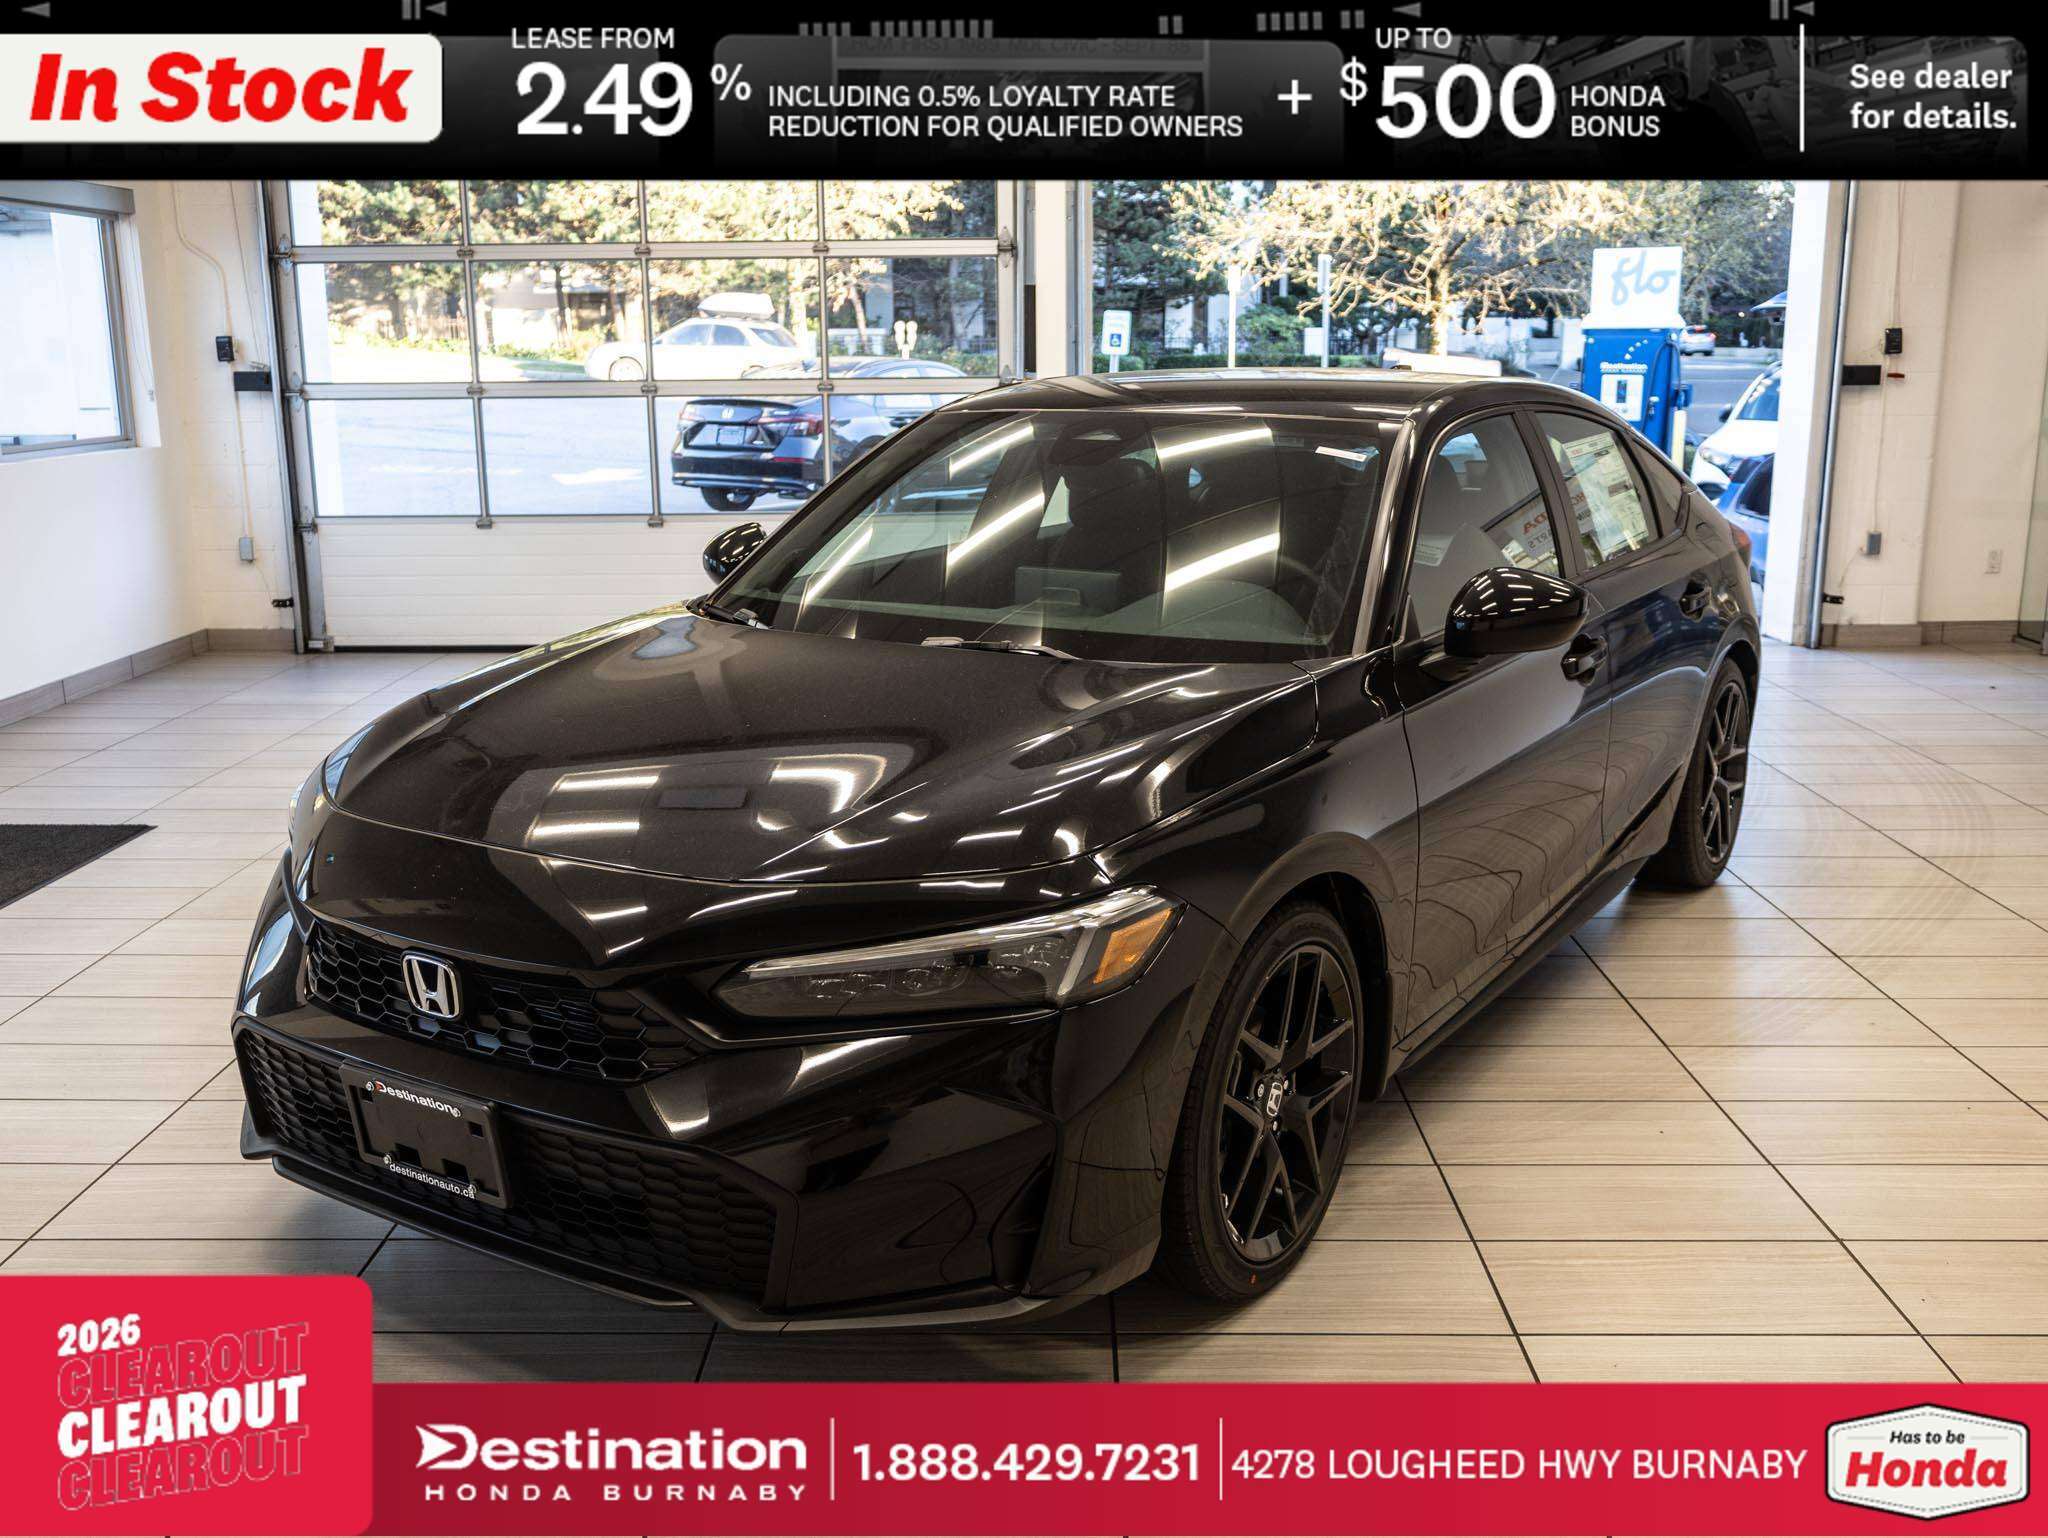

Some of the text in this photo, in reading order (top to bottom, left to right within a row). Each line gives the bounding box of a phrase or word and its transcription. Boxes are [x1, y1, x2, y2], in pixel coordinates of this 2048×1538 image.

[1612, 250, 1677, 306] flo
[374, 1080, 454, 1114] Destination
[390, 1162, 475, 1199] destinationauto.ca
